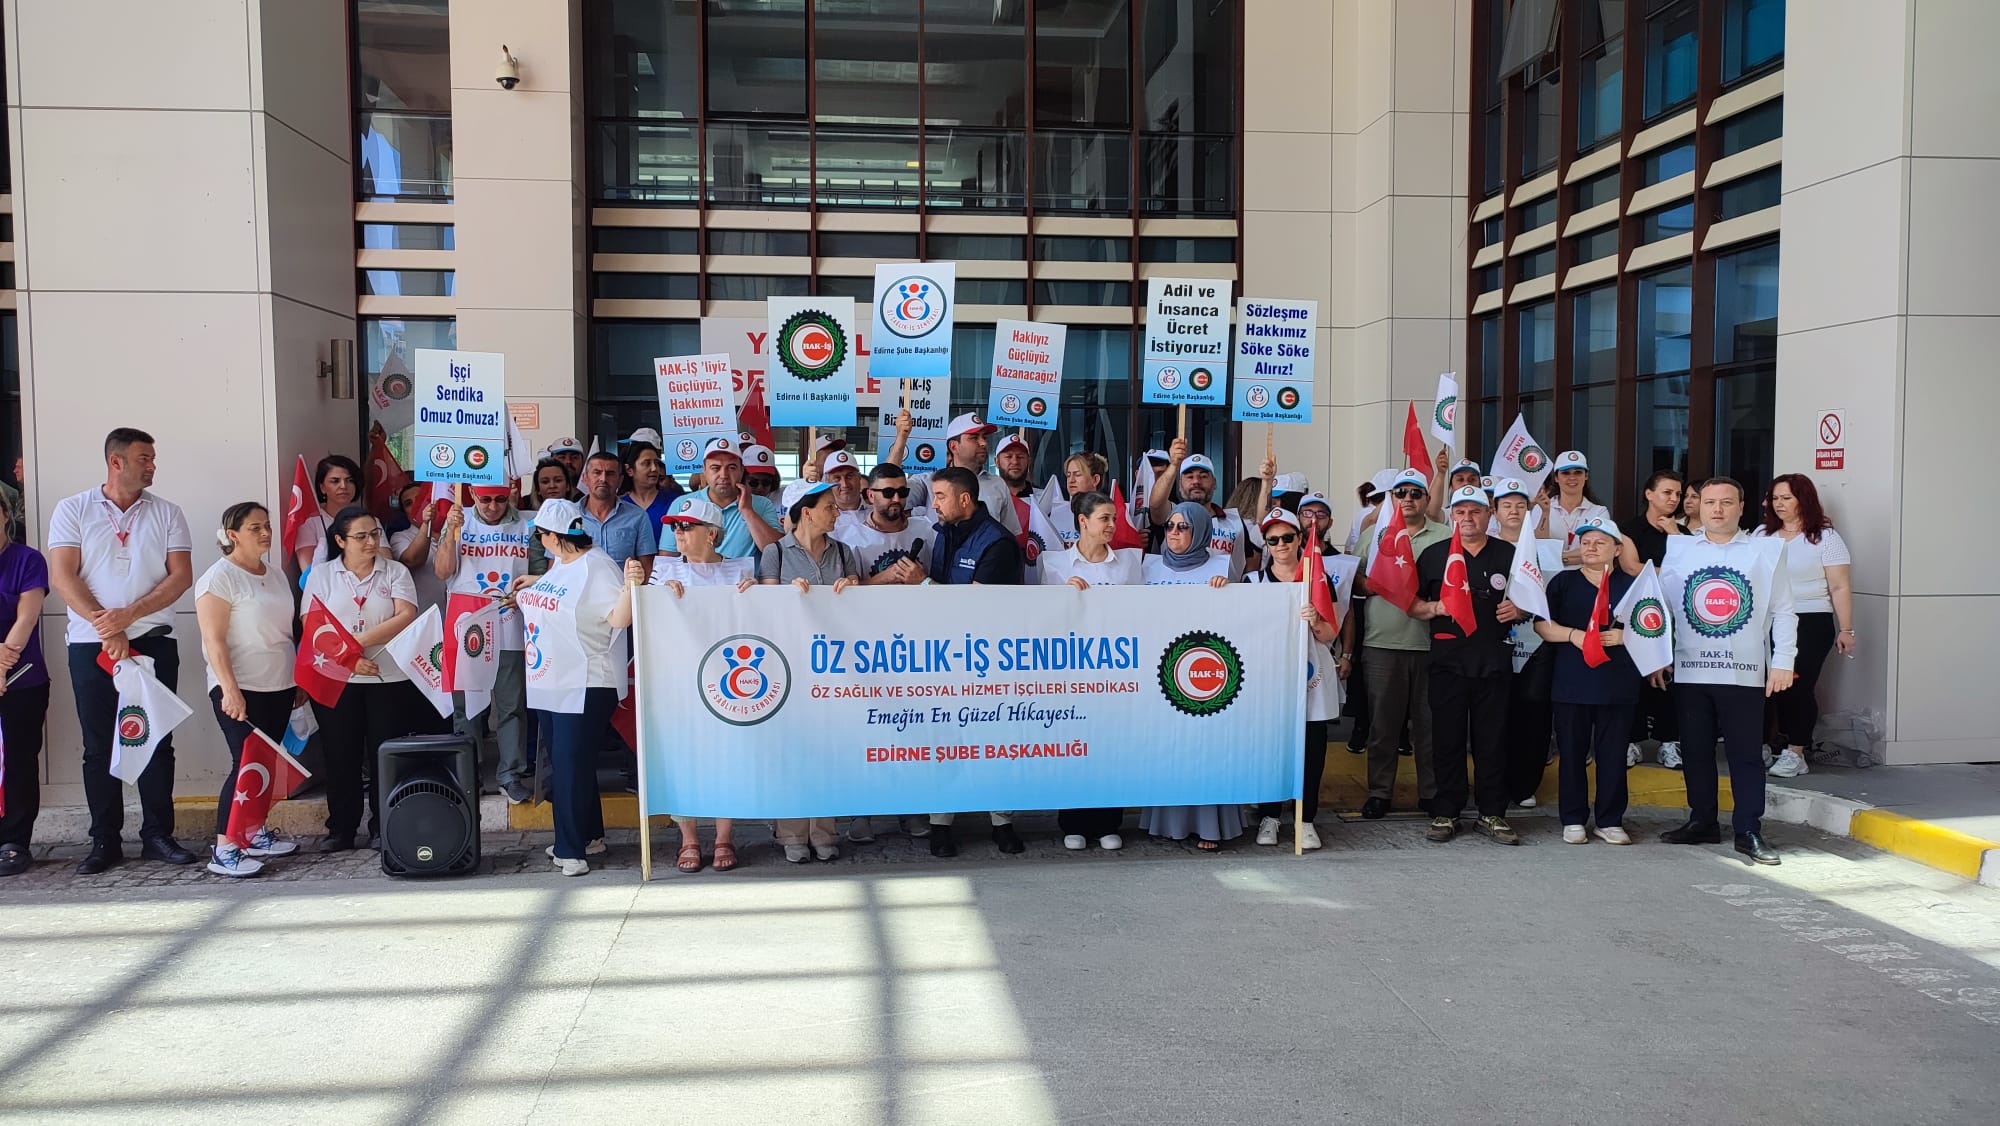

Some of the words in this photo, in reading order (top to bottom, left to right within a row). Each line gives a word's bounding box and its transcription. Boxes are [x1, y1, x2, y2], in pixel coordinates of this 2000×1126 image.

[1163, 284, 1192, 298] Adil
[1199, 286, 1215, 298] ve
[1158, 300, 1219, 317] İnsanca
[1246, 303, 1308, 322] Sözleşme
[1167, 318, 1208, 336] Ücret
[1246, 323, 1307, 339] Hakkımız
[1012, 329, 1049, 347] Haklıyız
[1151, 336, 1221, 356] İstiyoruz!
[802, 343, 832, 352] HAK-İŞ
[896, 347, 912, 355] Şube
[914, 346, 949, 355] Başkanlığı
[1241, 342, 1273, 356] Söke
[1277, 343, 1309, 358] Söke
[1008, 348, 1050, 365] Güçlüyüz
[450, 359, 471, 382] İşçi
[659, 360, 698, 377] HAK-İŞ
[701, 360, 727, 375] 'liyiz
[996, 365, 1058, 385] Kazanacağız!
[1255, 361, 1293, 376] Alırız!
[436, 385, 484, 403] Sendika
[668, 379, 722, 396] Güçlüyüz,
[670, 398, 724, 411] Hakkımızı
[776, 393, 800, 401] Edirne
[810, 393, 850, 403] Başkanlığı
[898, 396, 931, 410] Nrede
[420, 407, 452, 424] Omuz
[456, 409, 499, 426] Omuza!
[673, 413, 724, 429] İstiyoruz.
[426, 470, 445, 478] Edirne
[462, 472, 493, 481] Başkanlığı
[462, 530, 476, 543] ÖZ
[461, 543, 529, 559] SENDİKASI
[1705, 597, 1738, 607] HAK-İŞ
[811, 633, 846, 674] ÖZ
[854, 633, 990, 678] SAĞLIK-İŞ
[998, 631, 1139, 671] SENDİKASI
[1700, 649, 1734, 660] HAK-İŞ
[1189, 669, 1225, 680] HAK-İŞ
[811, 684, 830, 698] ÖZ
[834, 684, 882, 698] SAĞLIK
[886, 686, 903, 697] VE
[907, 685, 957, 697] SOSYAL
[962, 682, 1010, 696] HİZMET
[1014, 681, 1067, 696] İŞÇİLERİ
[1071, 680, 1139, 694] SENDİKASI
[867, 708, 925, 732] Emeğin
[931, 707, 951, 723] En
[958, 702, 1004, 728] Güzel
[1007, 701, 1087, 729] Hikayesi...
[866, 744, 931, 762] EDİRNE
[935, 745, 980, 763] ŞUBE
[985, 739, 1088, 761] BAŞKANLIĞI
